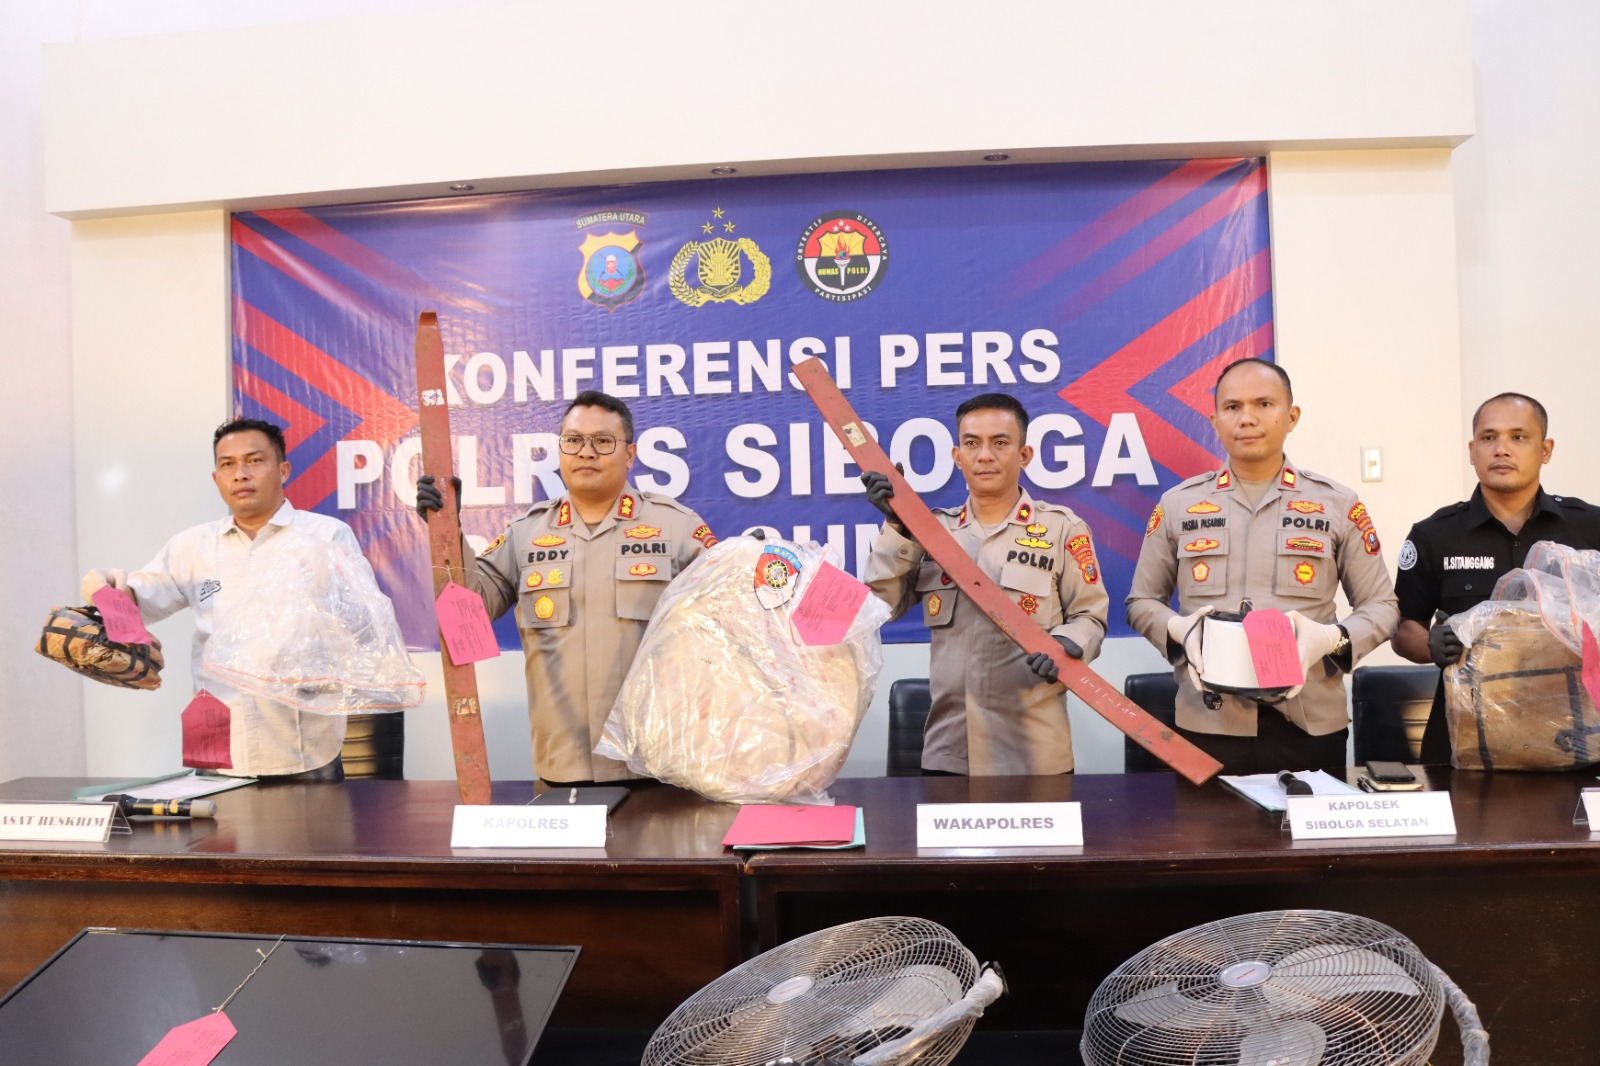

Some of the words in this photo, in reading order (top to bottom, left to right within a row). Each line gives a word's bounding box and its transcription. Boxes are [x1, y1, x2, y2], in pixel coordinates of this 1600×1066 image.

[576, 212, 618, 228] SUMATERA
[620, 213, 645, 225] UTARA
[797, 218, 822, 260] OBYEKTIF
[857, 215, 887, 260] DIPERCAYA
[814, 286, 872, 302] PARTISIPASI
[880, 329, 1060, 387] PERS
[336, 426, 690, 510] PLRS
[725, 412, 1158, 498] SIBOGA
[1283, 516, 1330, 532] POLRI
[527, 549, 569, 563] EDDY
[621, 543, 666, 555] POLRI
[1007, 550, 1054, 571] POLRI
[1444, 556, 1494, 570] H.SITANGGANG
[1328, 799, 1400, 811] KAPOLSEK
[0, 815, 36, 825] ASAT
[38, 815, 105, 827] RESKRIM
[483, 817, 569, 830] KAPOLRES
[933, 817, 1054, 830] WAKAPOLRES
[1305, 819, 1364, 830] SIBOLGA
[1368, 817, 1428, 828] SELATAN
